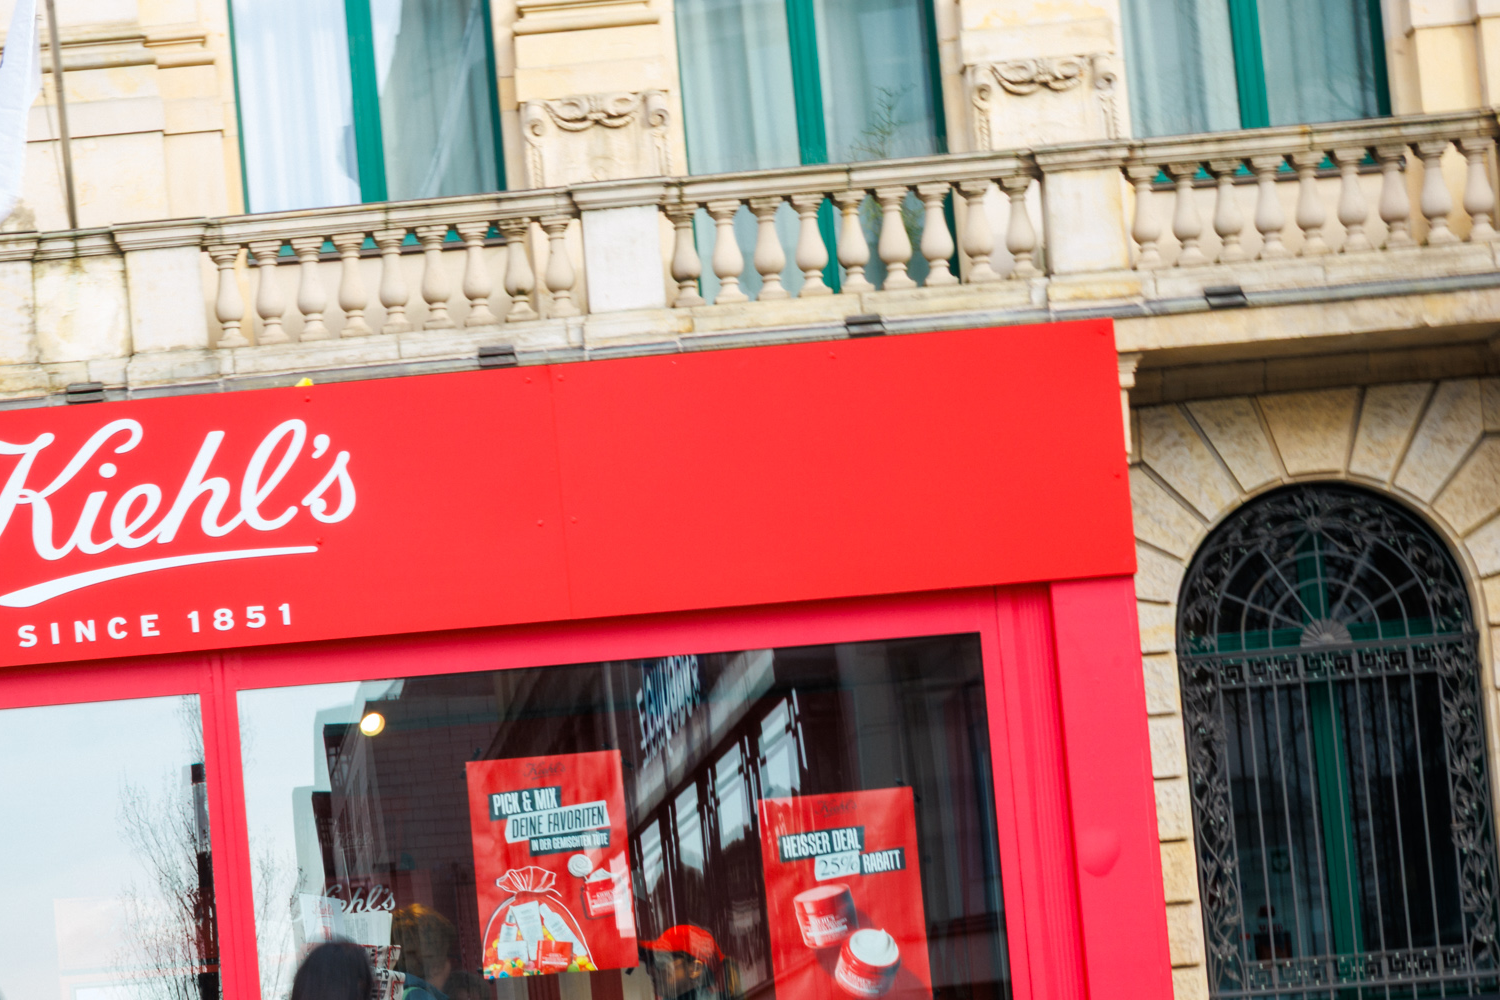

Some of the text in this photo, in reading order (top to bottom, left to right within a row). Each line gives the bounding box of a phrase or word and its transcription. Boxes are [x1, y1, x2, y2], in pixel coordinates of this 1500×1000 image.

[17, 602, 294, 648] SINCE 1851
[493, 787, 559, 816] PICK & MIX
[512, 805, 605, 838] DEINE FAVORITEN
[782, 827, 861, 858] HEISSER DEAL
[819, 849, 900, 877] 25% RABATT
